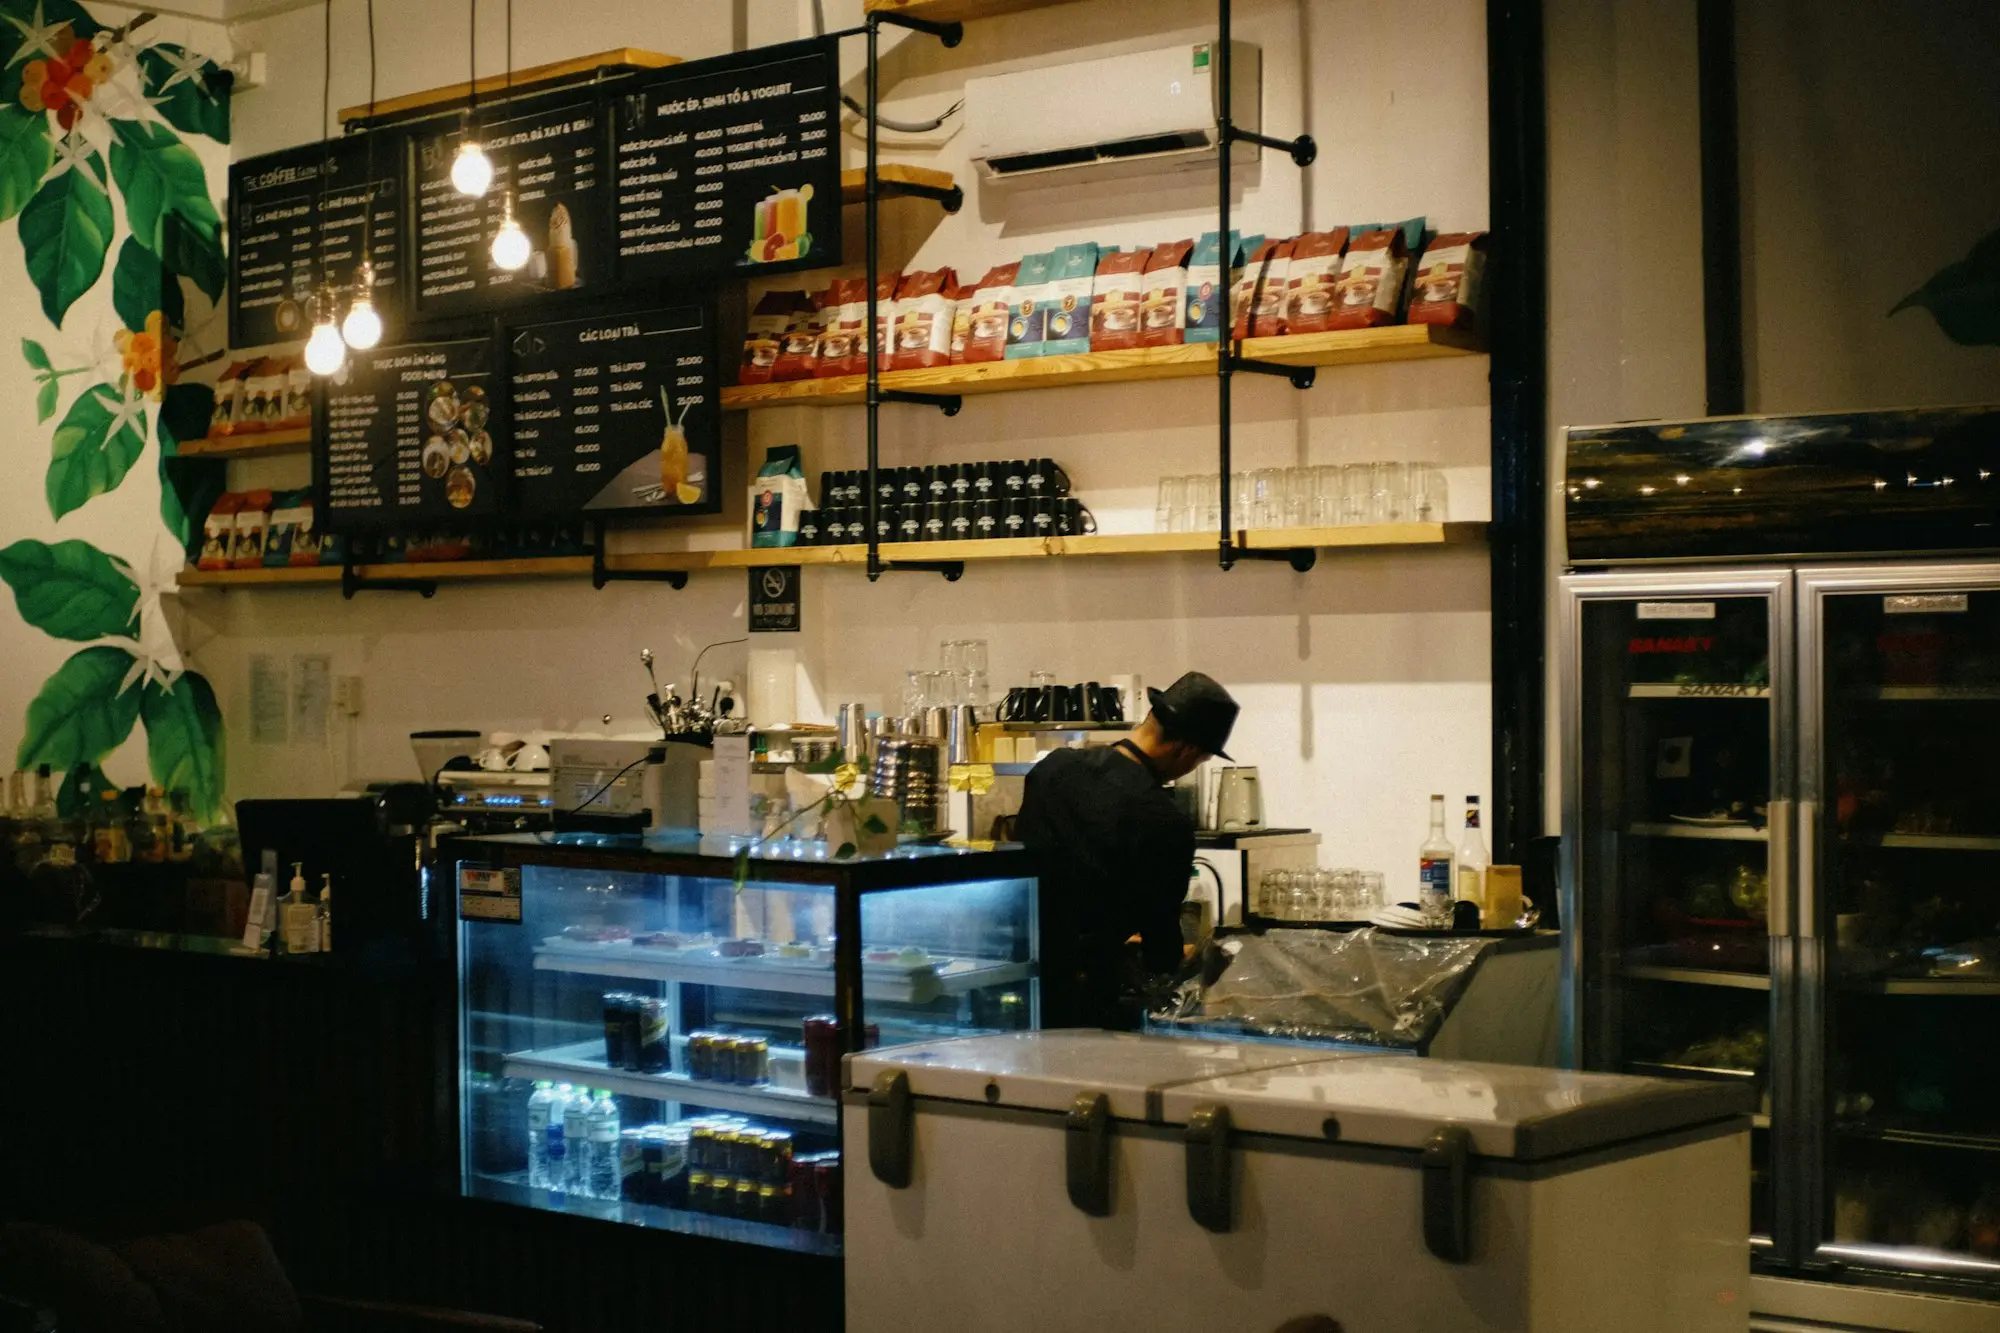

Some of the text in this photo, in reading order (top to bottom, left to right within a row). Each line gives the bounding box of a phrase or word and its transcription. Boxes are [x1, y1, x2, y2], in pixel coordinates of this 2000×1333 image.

[742, 91, 750, 102] &
[751, 82, 792, 100] YOGURT
[579, 330, 598, 342] CÁC
